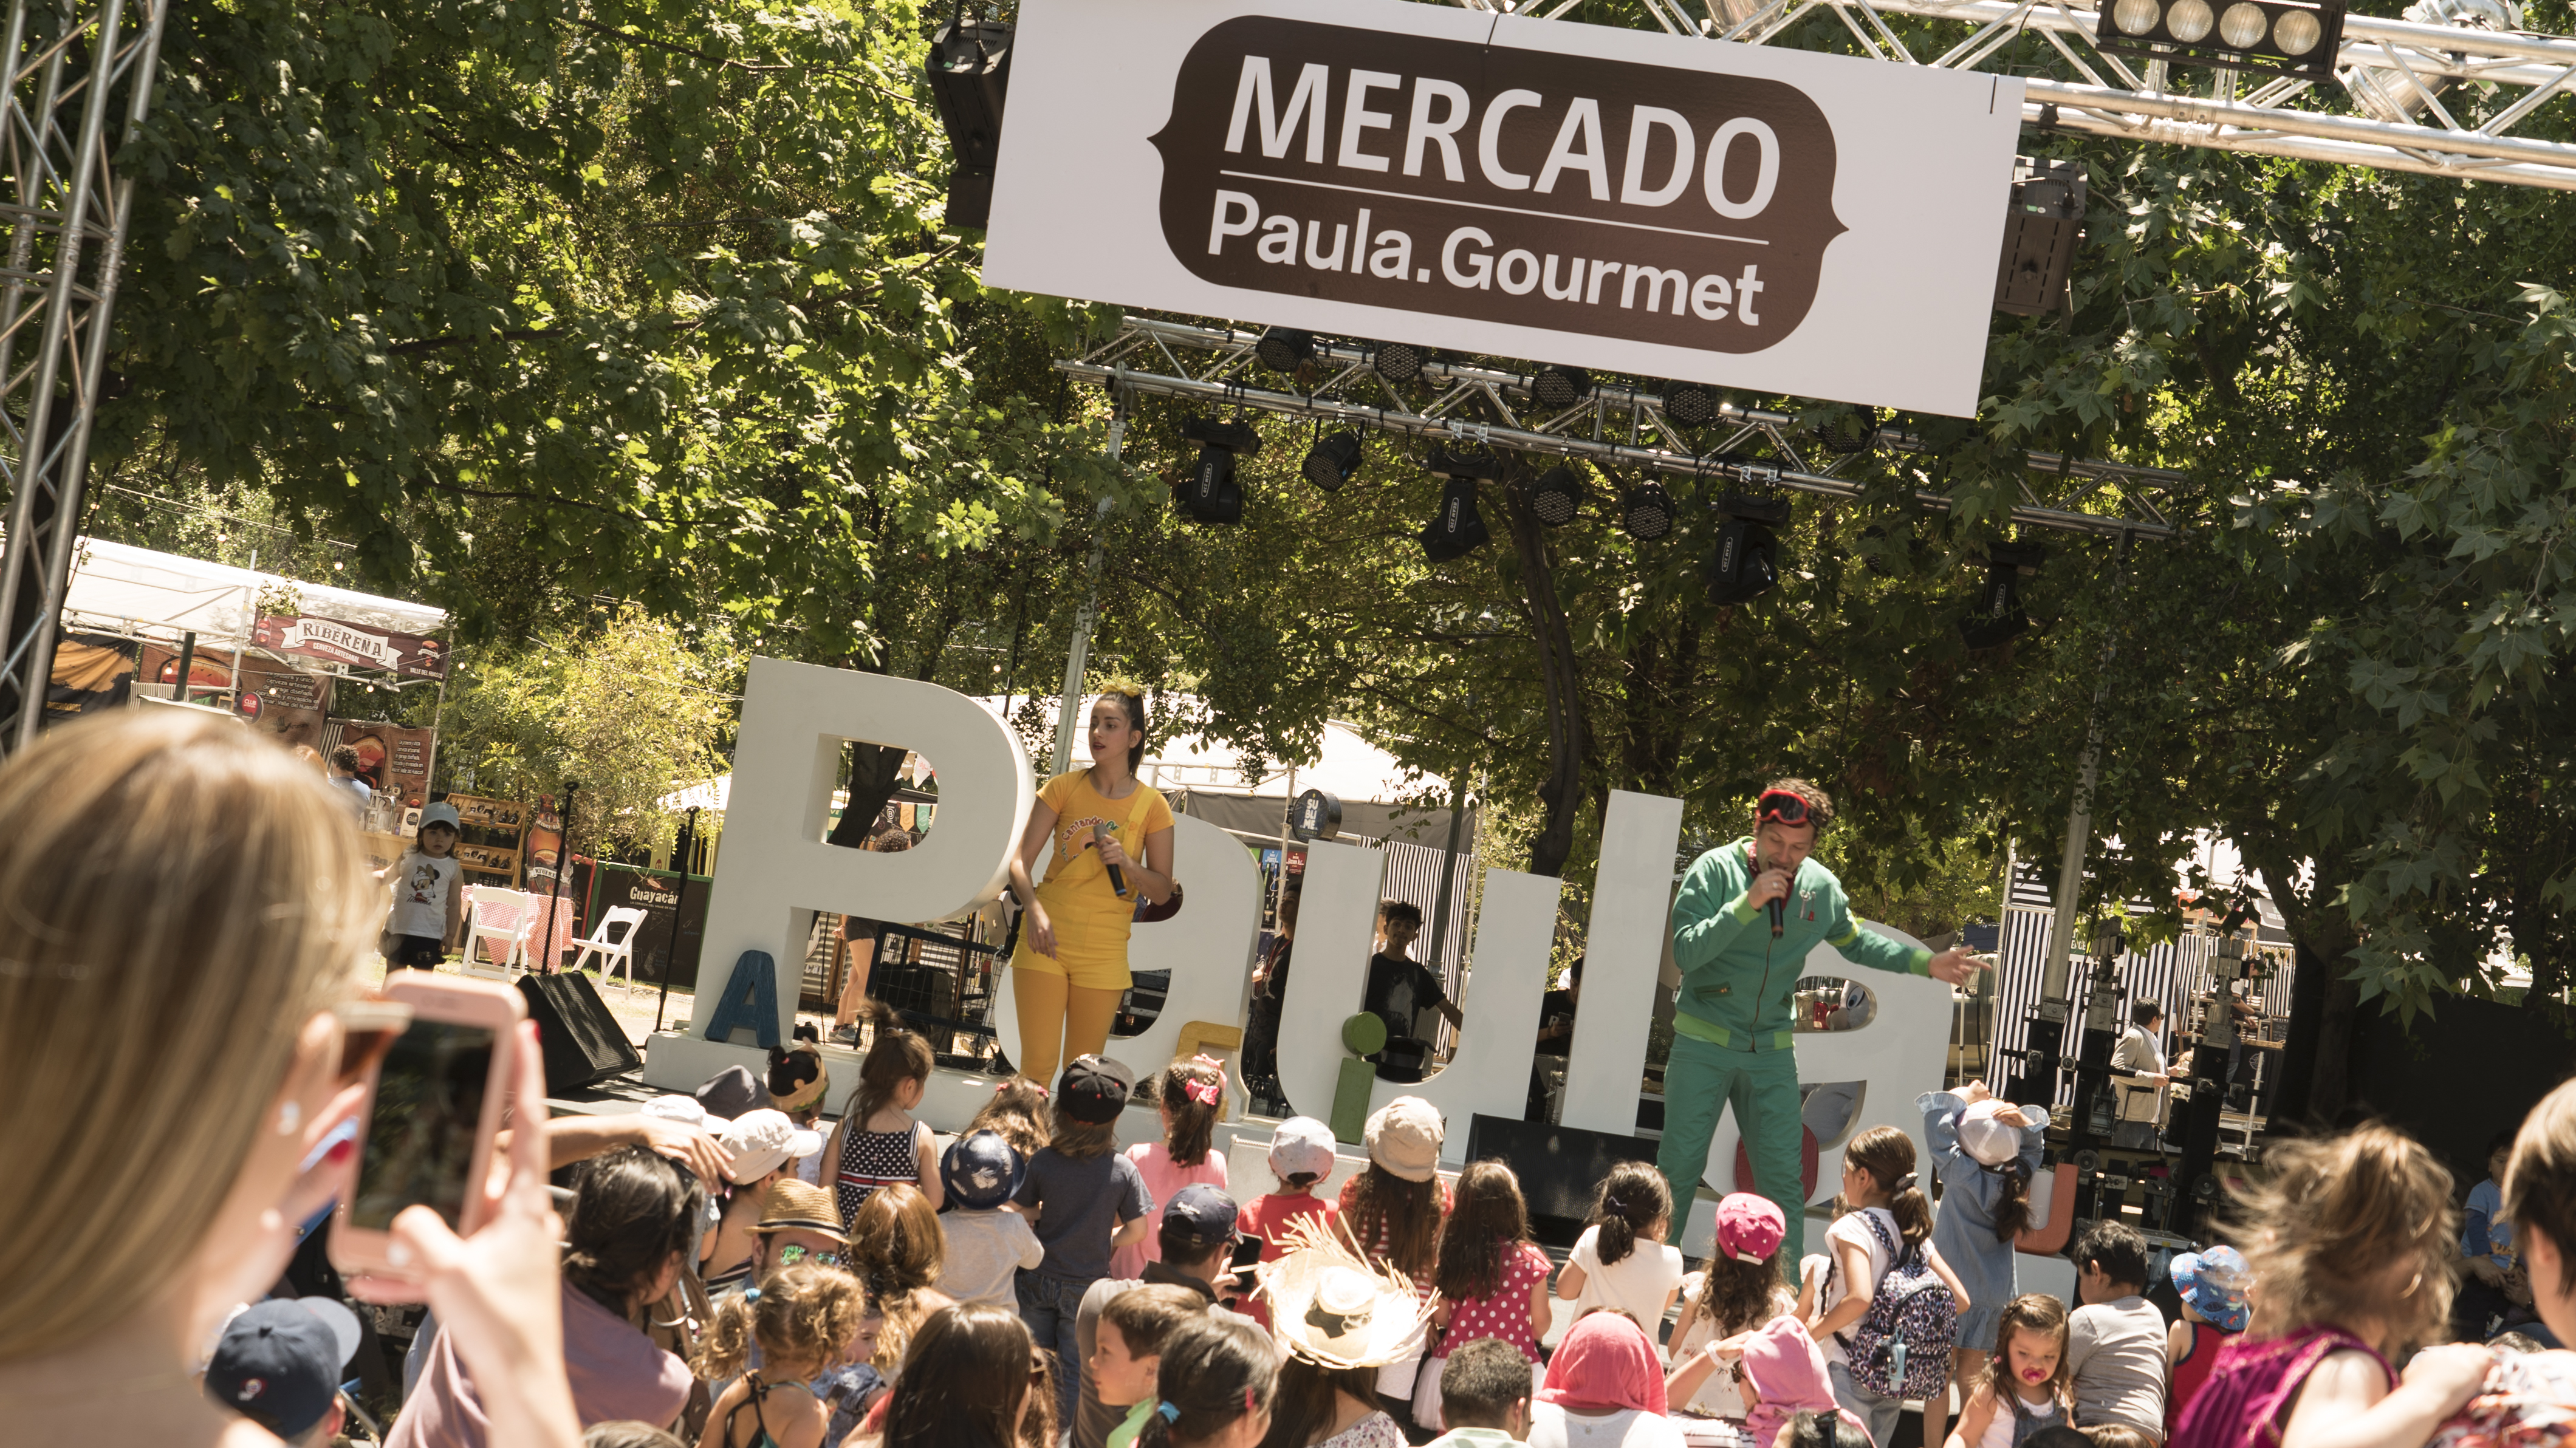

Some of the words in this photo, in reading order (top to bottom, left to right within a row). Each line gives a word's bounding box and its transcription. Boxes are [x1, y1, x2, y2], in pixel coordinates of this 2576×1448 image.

[1224, 55, 1780, 219] MERCADO
[1208, 189, 1764, 326] Paula.Gourmet
[303, 623, 382, 657] RIBEREÑA
[313, 643, 334, 654] CERVEZA
[334, 649, 360, 664] ARTESANAL
[1307, 798, 1318, 810] SU
[1061, 815, 1105, 841] Cantando
